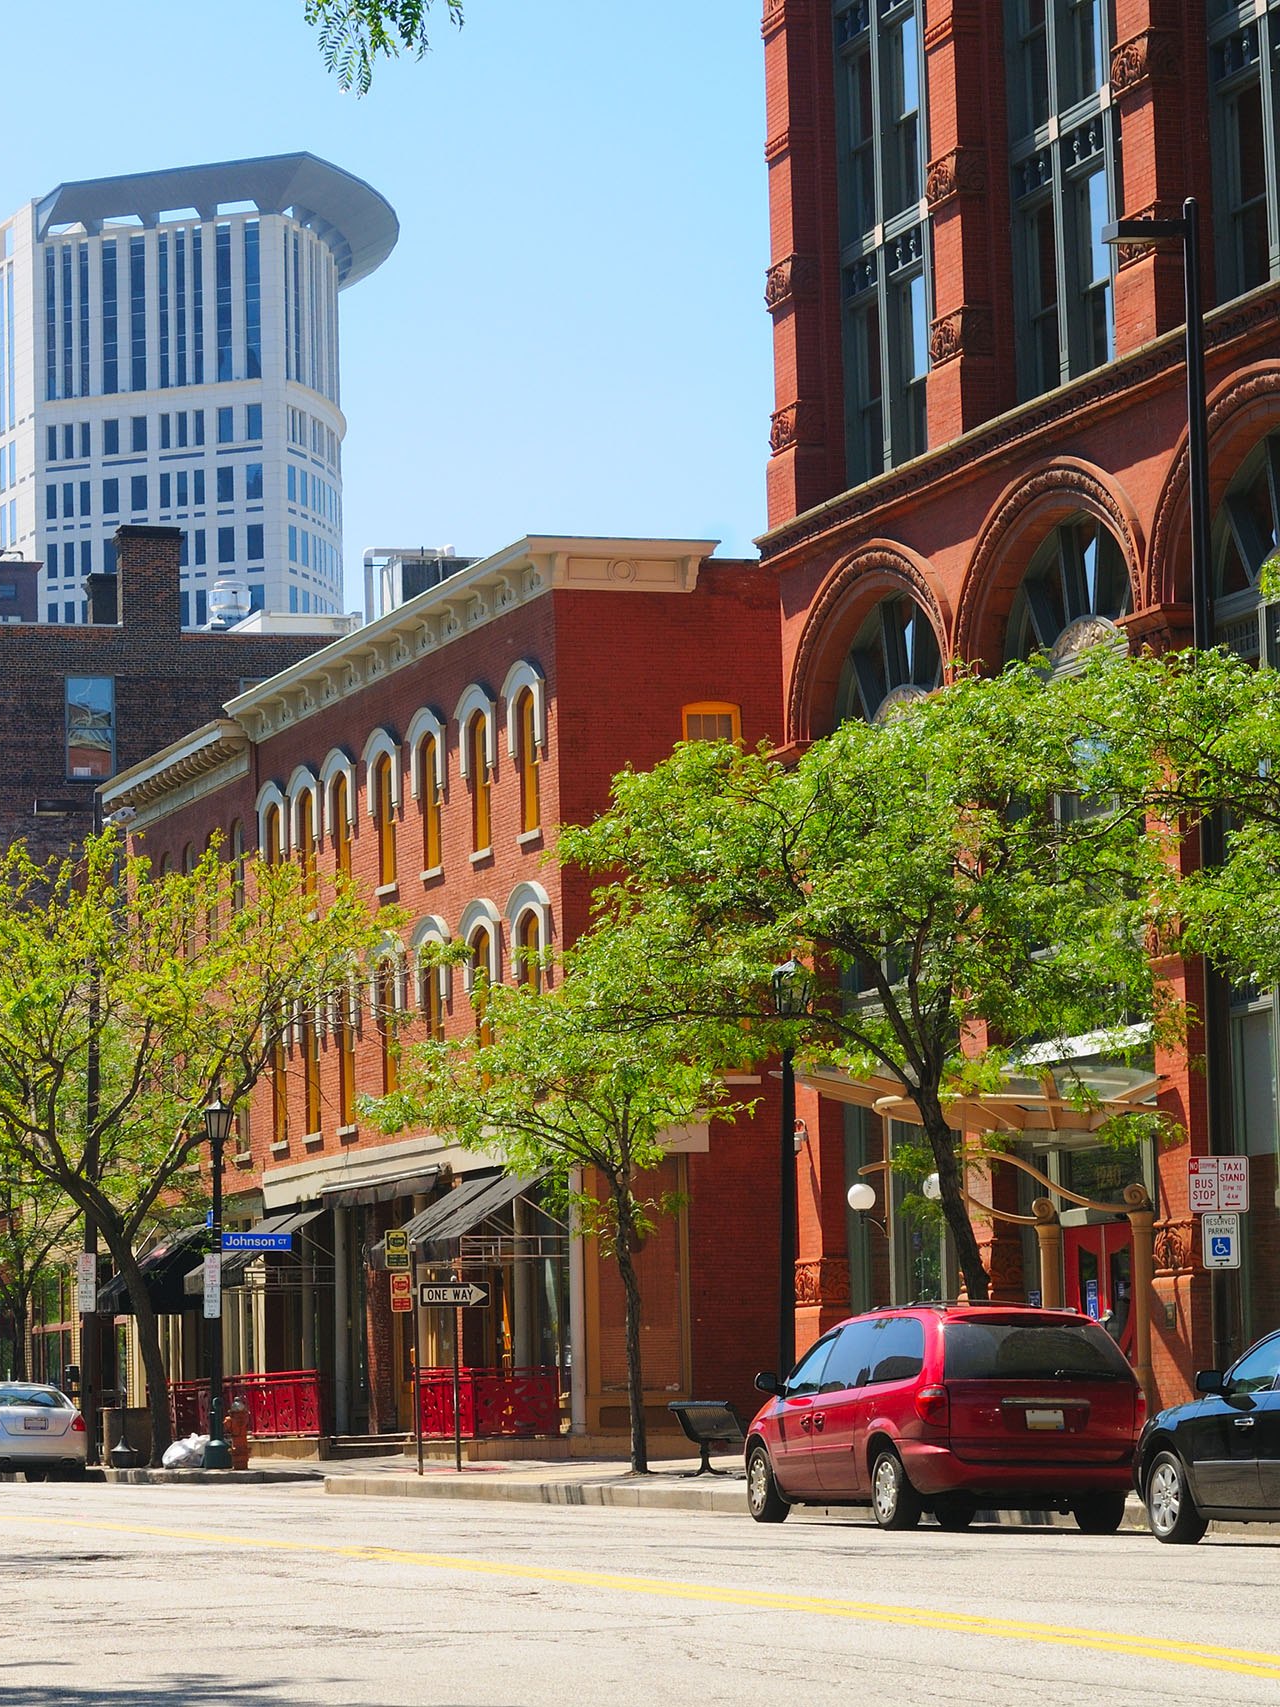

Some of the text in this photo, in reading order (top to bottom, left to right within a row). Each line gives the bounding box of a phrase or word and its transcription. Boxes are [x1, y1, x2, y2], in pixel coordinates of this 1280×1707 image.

[1190, 1161, 1199, 1171] NO
[1220, 1174, 1245, 1182] STAND
[1195, 1180, 1213, 1188] BUS
[1193, 1191, 1215, 1199] STOP
[225, 1236, 275, 1246] Johnson
[428, 1290, 473, 1300] ONE WAY
